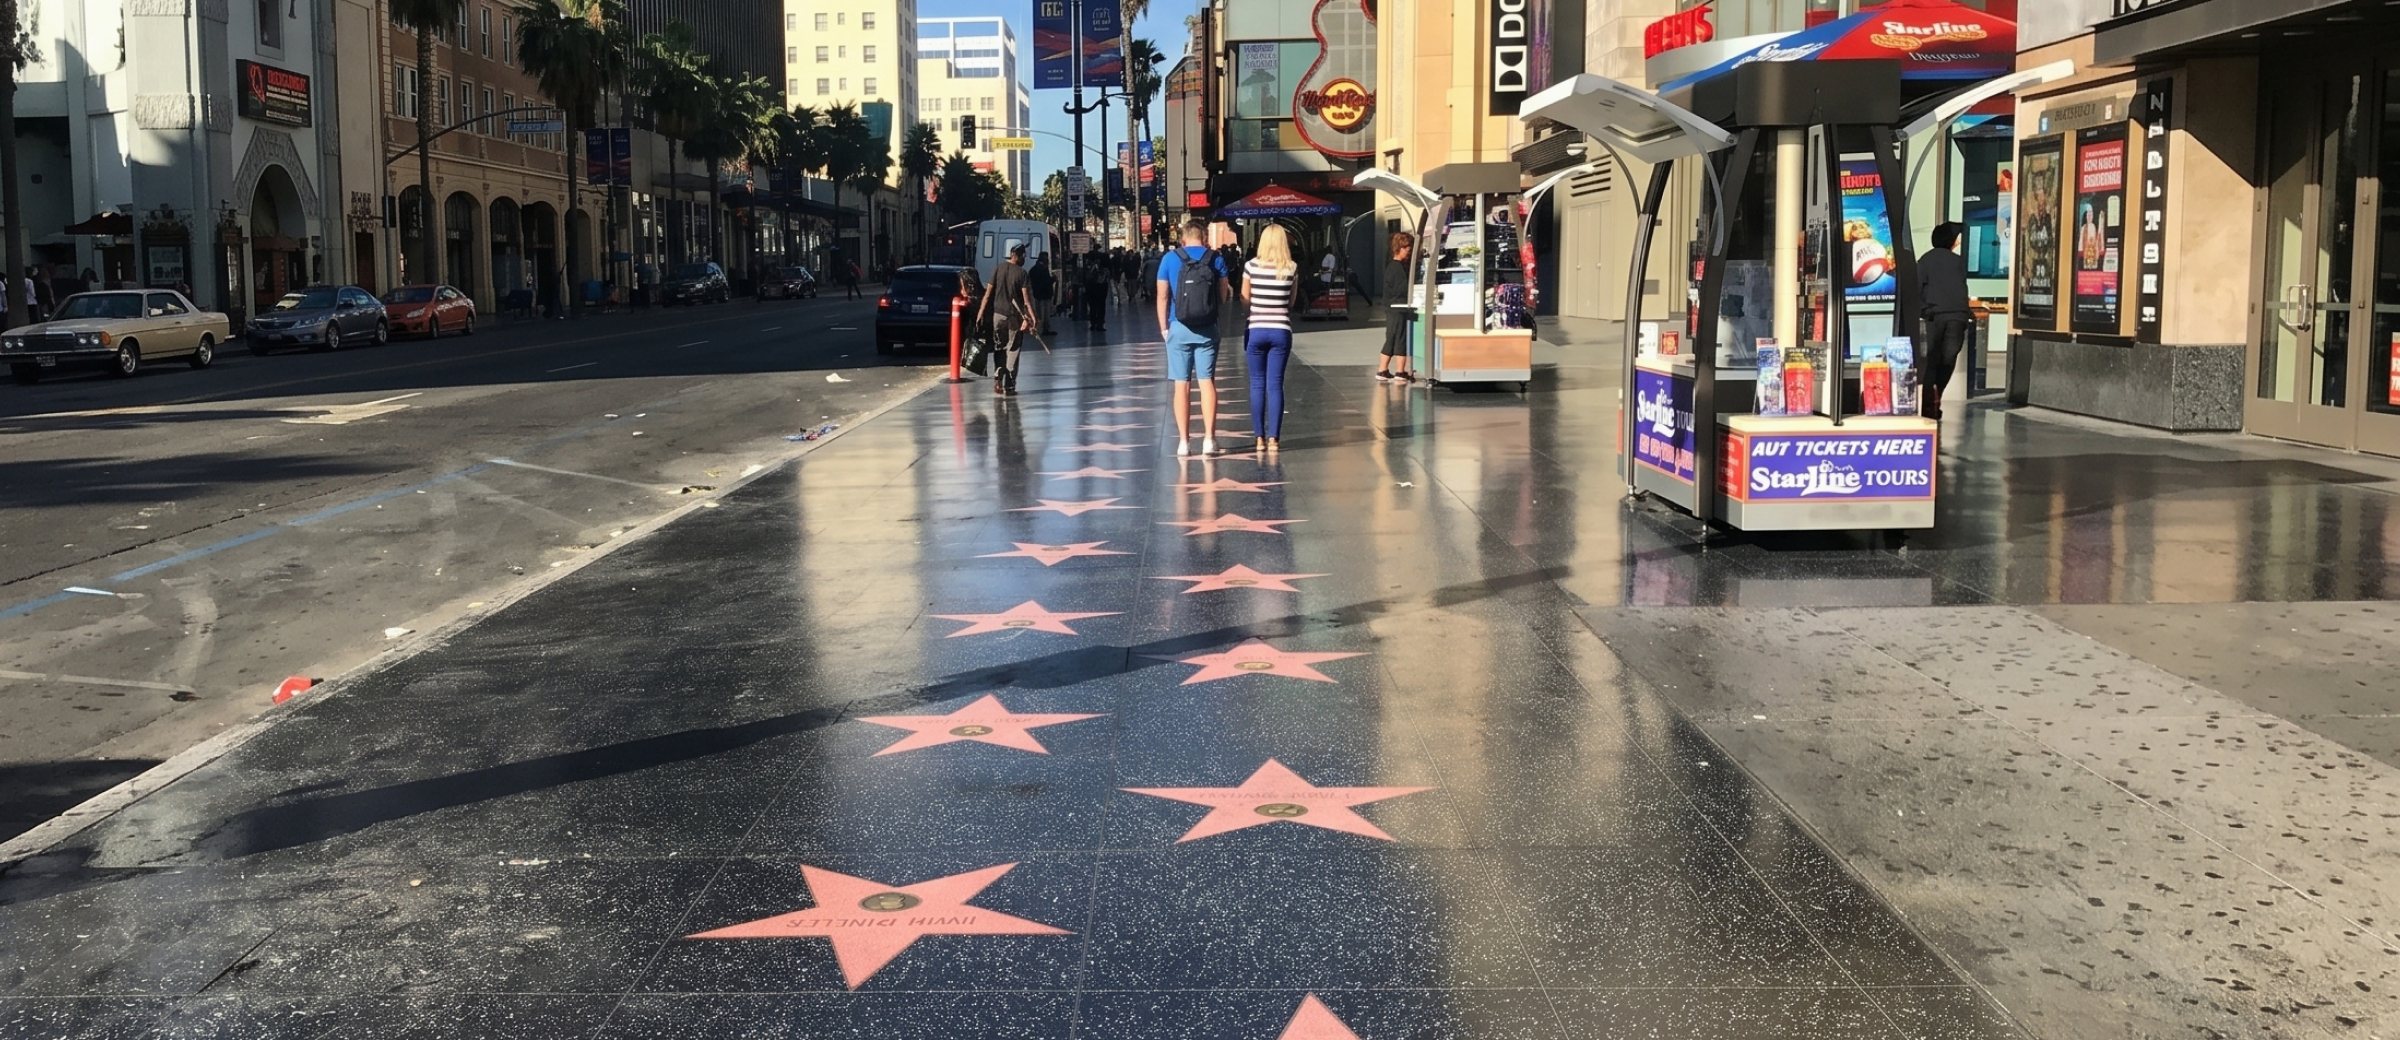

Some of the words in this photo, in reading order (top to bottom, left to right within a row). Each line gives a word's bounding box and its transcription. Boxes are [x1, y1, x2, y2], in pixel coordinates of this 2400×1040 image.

[1795, 440, 1871, 457] TICKETS
[1872, 438, 1927, 456] HERE
[1863, 469, 1930, 486] TOURS
